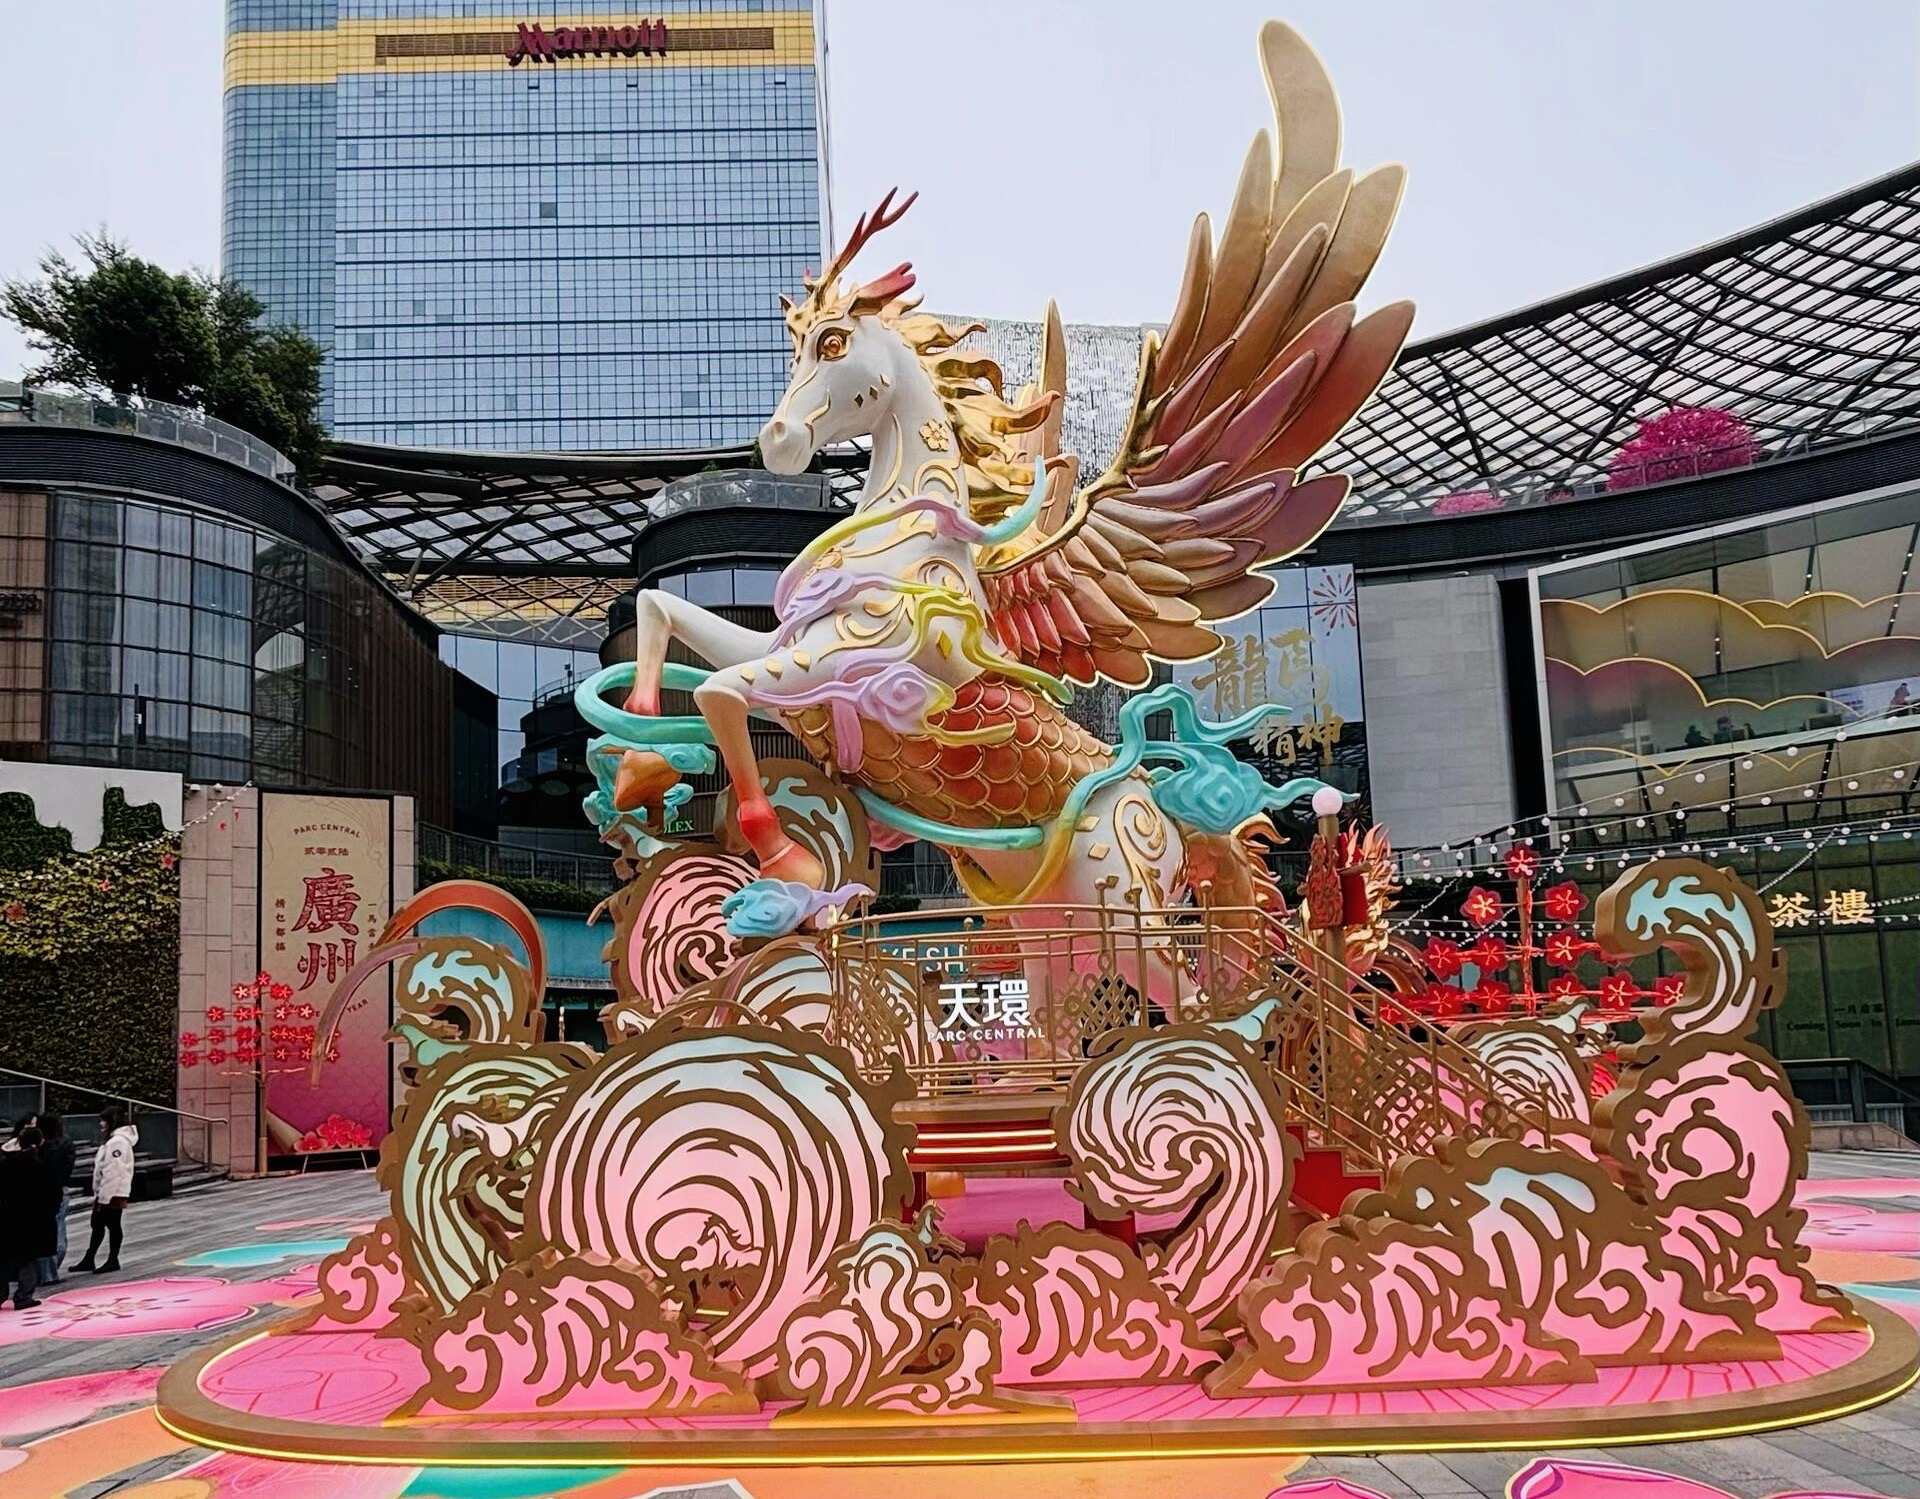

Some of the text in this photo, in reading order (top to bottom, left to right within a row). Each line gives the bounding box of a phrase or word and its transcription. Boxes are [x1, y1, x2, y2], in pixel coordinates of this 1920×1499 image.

[505, 18, 667, 62] Marriott
[1250, 703, 1344, 768] 精神
[294, 824, 360, 839] PARC CENTRAL
[664, 820, 694, 833] LEX
[1767, 889, 1875, 928] 茶樓
[291, 867, 362, 992] 廣州
[346, 999, 368, 1013] YEAR
[938, 979, 1031, 1028] 天環
[927, 1027, 1045, 1042] PARC CENTRAL
